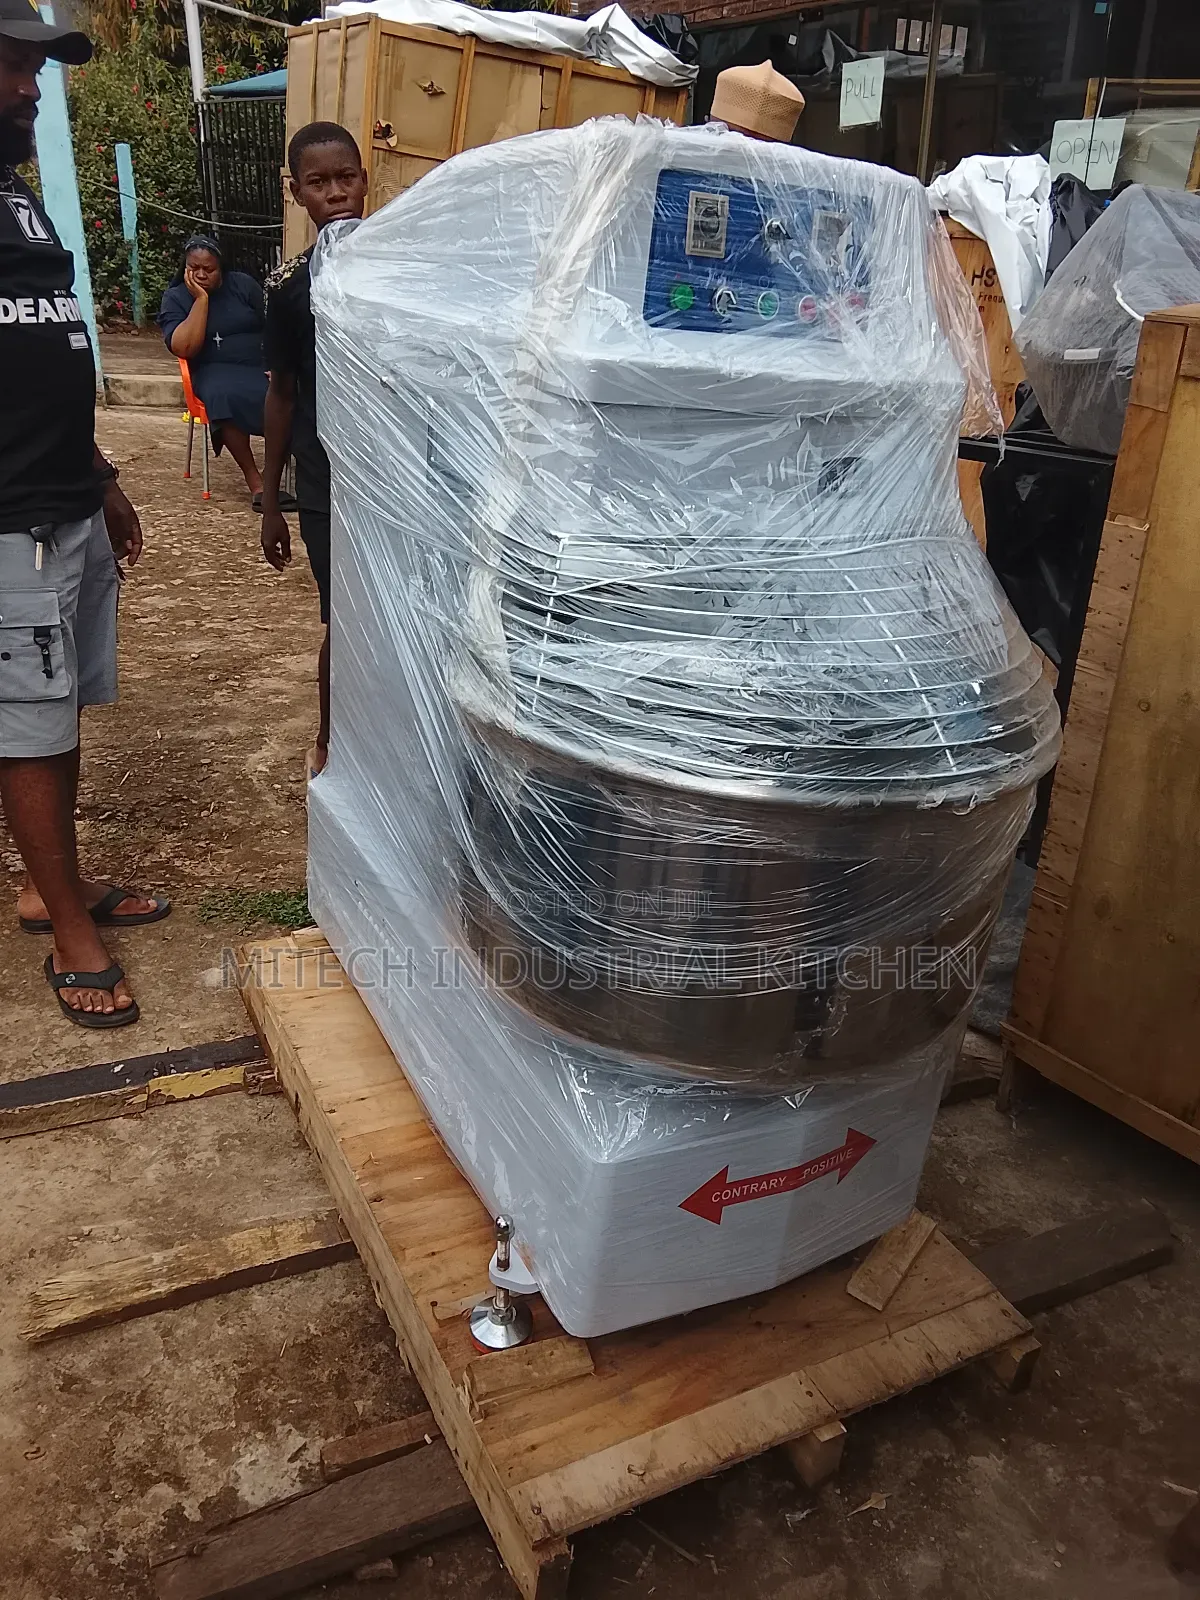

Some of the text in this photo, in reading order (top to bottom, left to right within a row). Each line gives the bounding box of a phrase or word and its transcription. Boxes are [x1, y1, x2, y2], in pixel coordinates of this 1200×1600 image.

[1056, 137, 1116, 165] OPEN
[711, 1148, 853, 1204] CONTRARY POSITIVE
